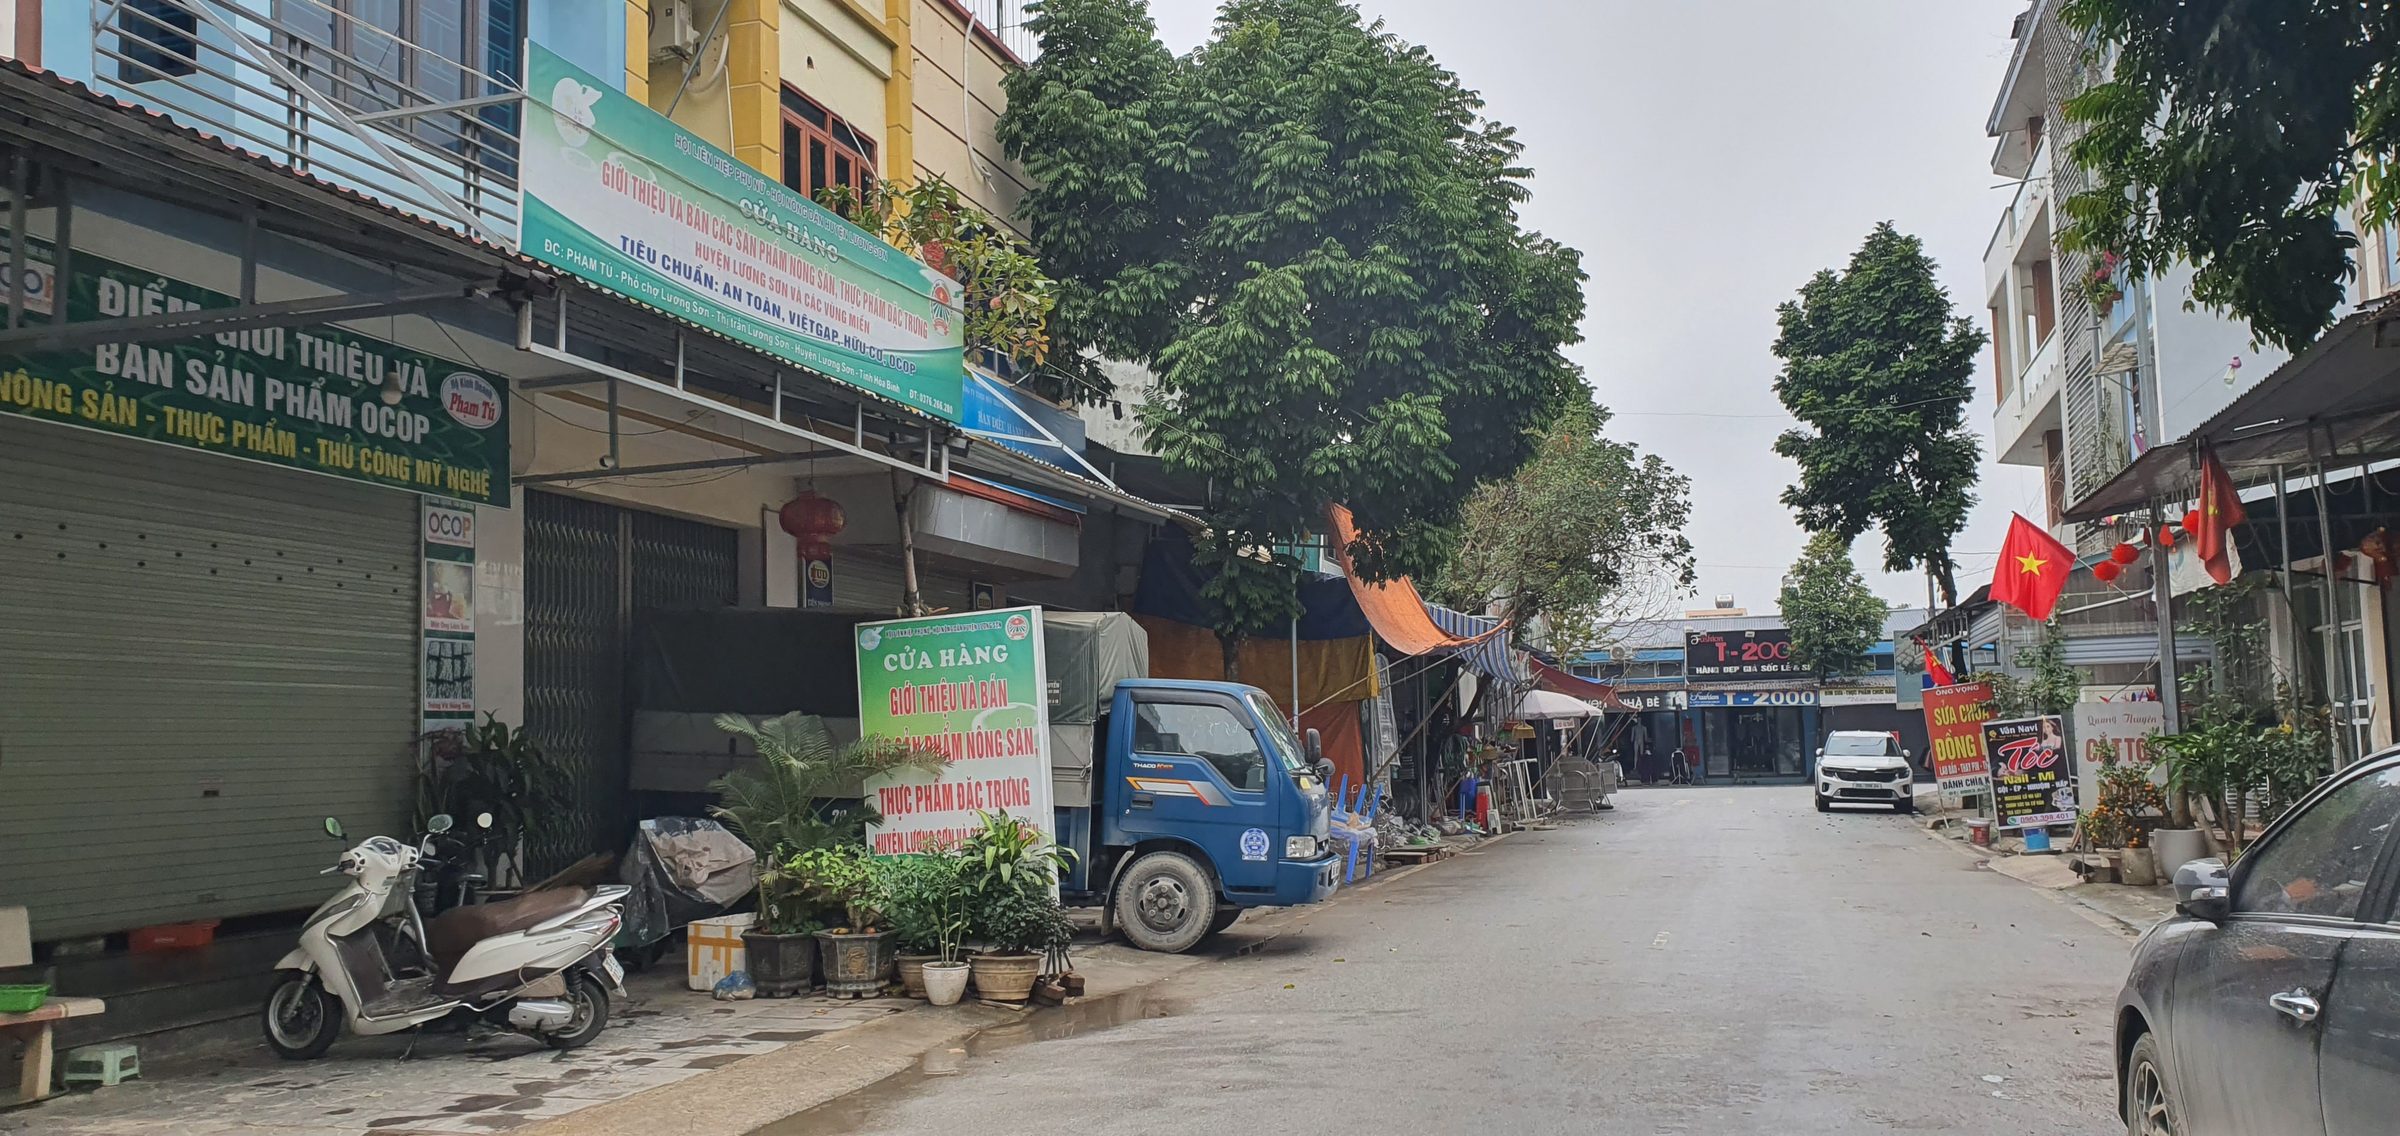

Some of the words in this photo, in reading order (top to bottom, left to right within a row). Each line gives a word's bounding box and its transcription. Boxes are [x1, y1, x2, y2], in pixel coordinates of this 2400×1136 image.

[674, 133, 690, 156] HỘI
[693, 141, 712, 166] LIÊN
[602, 160, 629, 196] GIỚI
[632, 175, 666, 216] THIỆU
[669, 192, 684, 223] VÀ
[686, 201, 709, 235] BÁN
[712, 213, 733, 246] CÁC
[736, 223, 757, 259] SẢN
[759, 236, 788, 273] PHẨM
[790, 252, 815, 287] NÔNG
[840, 281, 861, 310] THỰC
[739, 196, 783, 236] CỬA
[787, 220, 841, 263] HÀNG
[544, 238, 564, 259] ĐC:
[566, 248, 597, 272] PHẠM
[599, 261, 613, 278] TÚ
[620, 270, 640, 289] Phố
[641, 281, 660, 298] chợ
[661, 287, 691, 313] Lương
[692, 302, 710, 318] Sơn
[748, 324, 773, 346] Lương
[695, 241, 731, 271] HUYỆN
[733, 259, 766, 288] LƯƠNG
[768, 276, 788, 298] SƠN
[790, 284, 801, 305] VÀ
[804, 290, 822, 316] CÁC
[620, 235, 657, 265] TIÊU
[661, 254, 719, 293] CHUẨN:
[723, 281, 743, 302] AN
[746, 291, 785, 323] TOÀN,
[844, 333, 867, 356] HỮU
[889, 354, 917, 377] OCOP
[296, 331, 384, 388] THIỆU
[394, 357, 430, 399] VÀ
[185, 350, 255, 407] SẢN
[265, 376, 352, 429] PHẨM
[361, 401, 430, 445] OCOP
[449, 392, 480, 418] Phạm
[482, 400, 496, 421] Tú
[81, 380, 138, 427] SẢN
[163, 404, 225, 448] THỰC
[232, 417, 296, 460] PHẨM
[317, 433, 354, 470] THỦ
[360, 443, 410, 481] CÔNG
[415, 458, 442, 487] MỸ
[447, 464, 491, 501] NGHỆ
[429, 511, 472, 539] OCOP
[883, 645, 933, 672] CỬA
[939, 643, 1009, 667] HÀNG
[889, 681, 917, 717] GIỚI
[920, 678, 957, 718] THIỆU
[960, 676, 977, 711] VÀ
[979, 673, 1008, 709] BÁN
[1934, 700, 1957, 726] SỬA
[924, 721, 963, 762] PHẨM
[966, 725, 1003, 760] NÔNG
[1006, 718, 1040, 759] SẢN,
[2017, 723, 2038, 733] Navi
[2088, 715, 2117, 727] Quang
[1935, 729, 1977, 761] ĐỒNG
[1998, 737, 2059, 772] Tóc
[879, 784, 913, 821] THỰC
[915, 773, 954, 814] PHẨM
[957, 776, 983, 816] ĐẶC
[986, 776, 1031, 809] TRƯNG
[2003, 774, 2029, 785] Nail
[2038, 771, 2055, 782] Mi
[875, 828, 904, 857] HUYỆN
